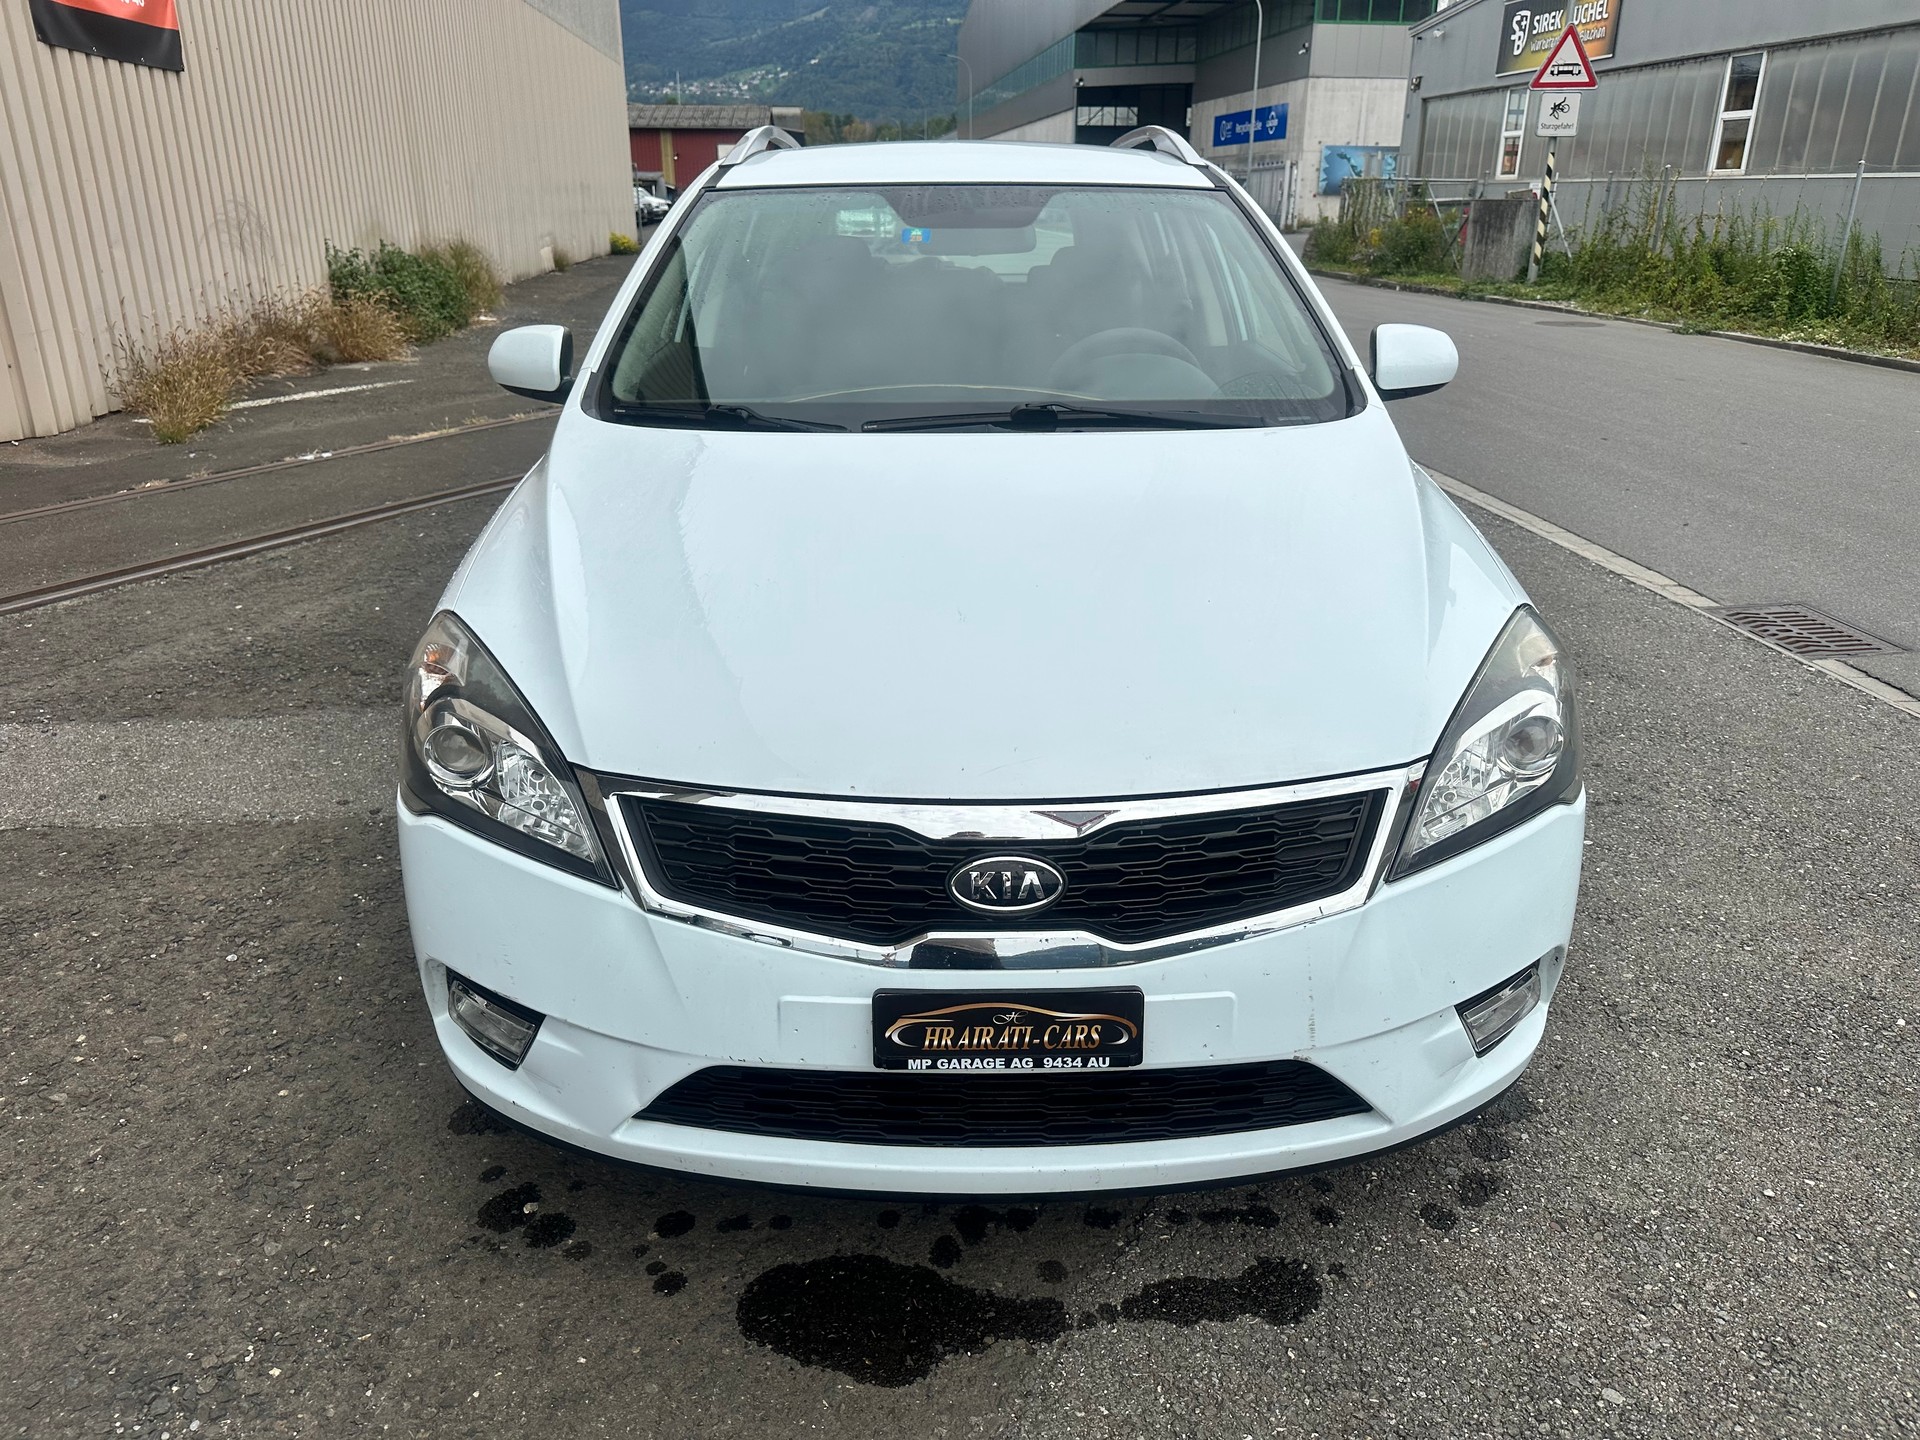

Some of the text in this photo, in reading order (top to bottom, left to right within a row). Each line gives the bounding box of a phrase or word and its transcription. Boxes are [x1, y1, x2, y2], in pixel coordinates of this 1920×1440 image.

[1532, 9, 1564, 35] SIREK
[969, 870, 1045, 900] KIA
[921, 1024, 1102, 1051] HRAIRATI-CARS
[907, 1056, 1110, 1070] MP GARAGE AG 9434 AU
